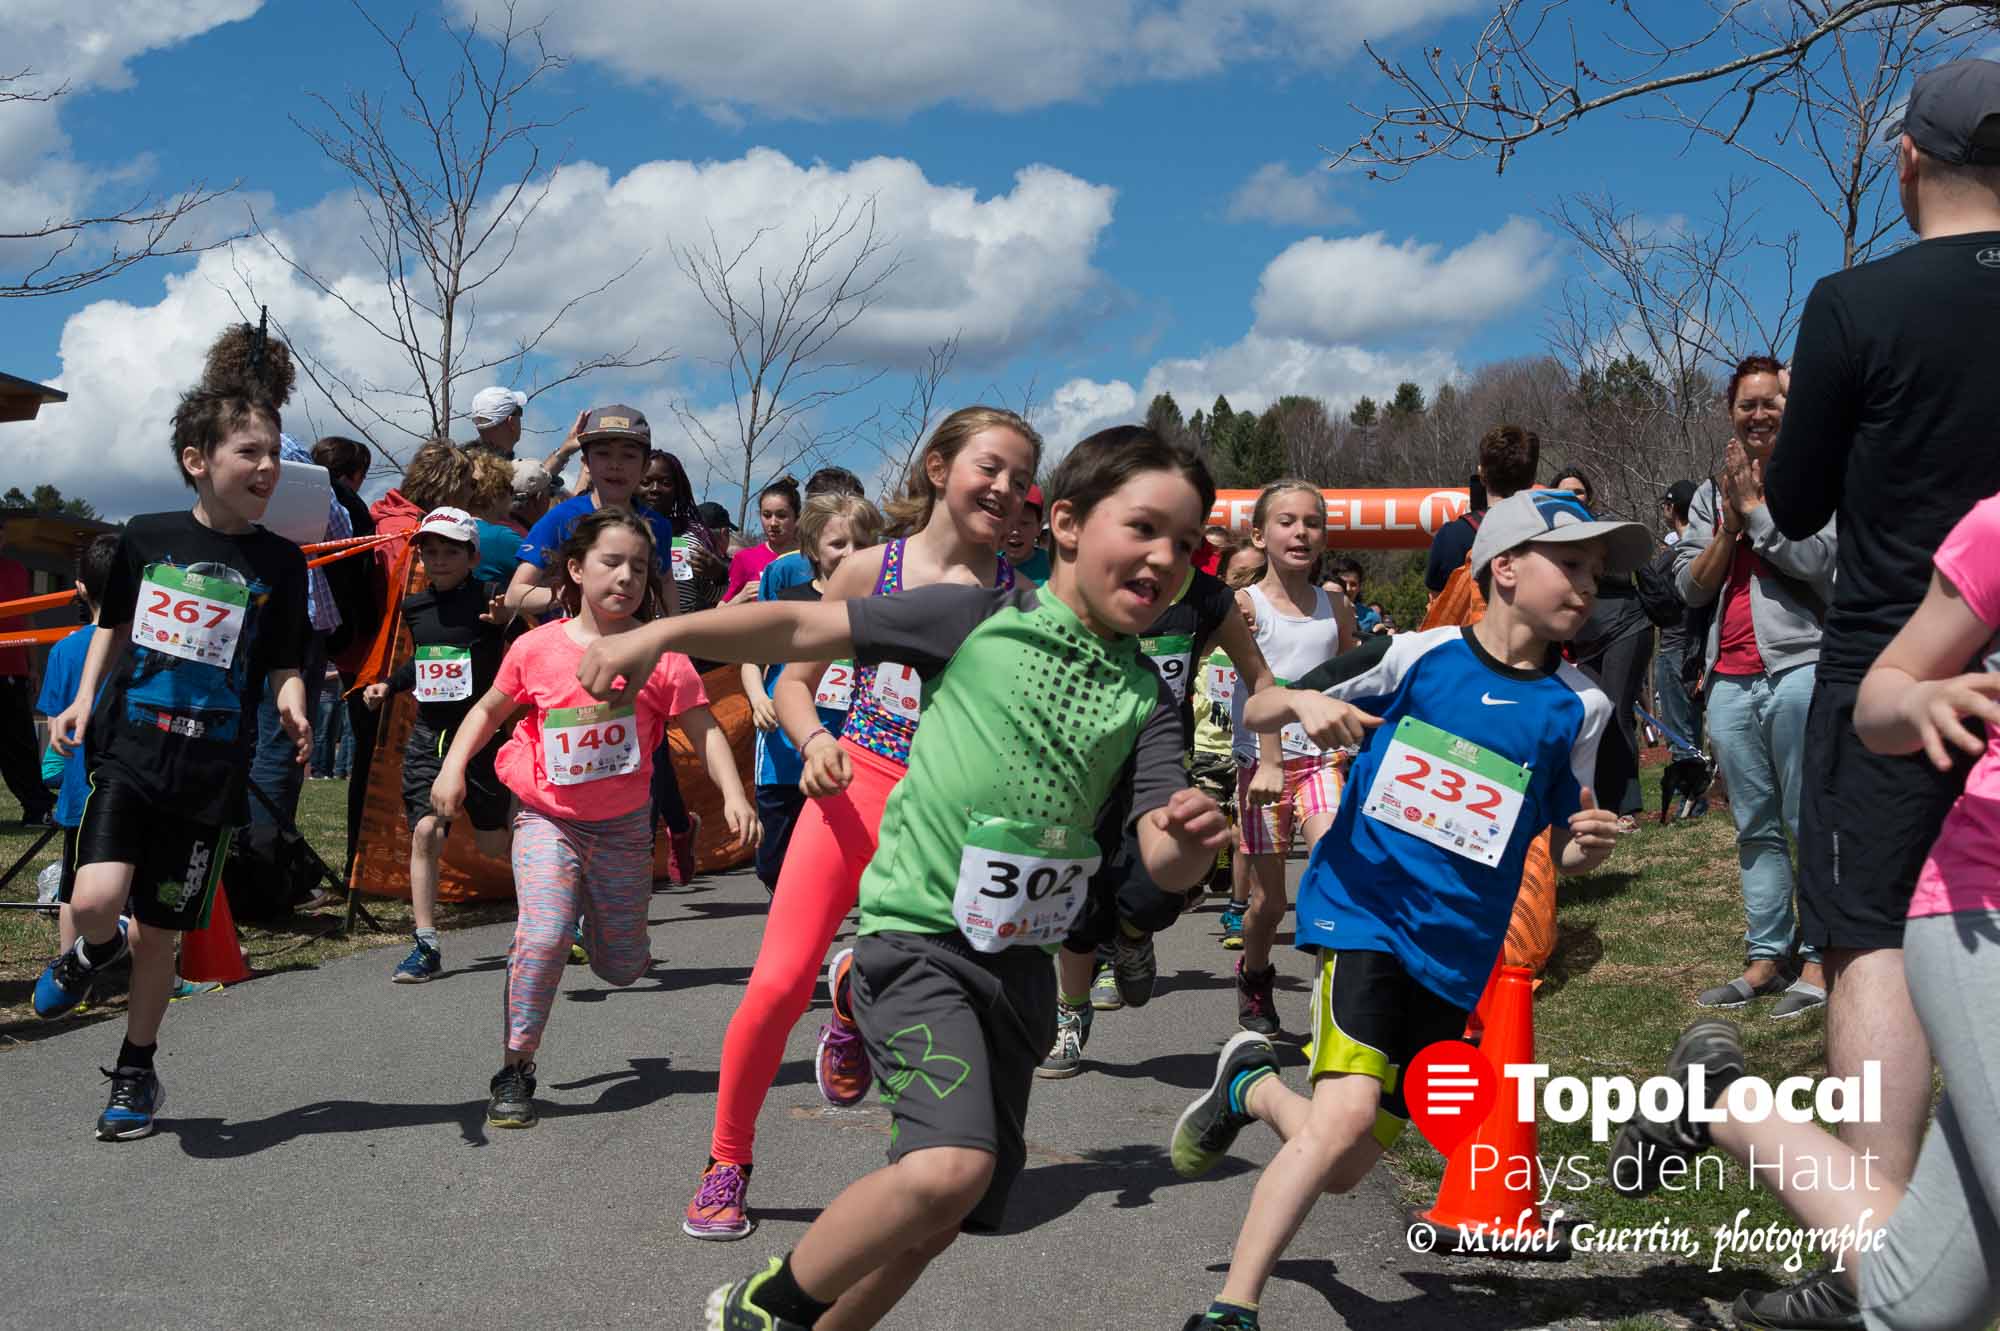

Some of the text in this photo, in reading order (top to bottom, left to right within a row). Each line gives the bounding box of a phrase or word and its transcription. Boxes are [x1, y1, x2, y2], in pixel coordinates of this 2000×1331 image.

[147, 590, 231, 629] 267
[418, 663, 463, 680] 198
[555, 724, 626, 754] 140
[1395, 755, 1503, 821] 232
[979, 861, 1083, 901] 302
